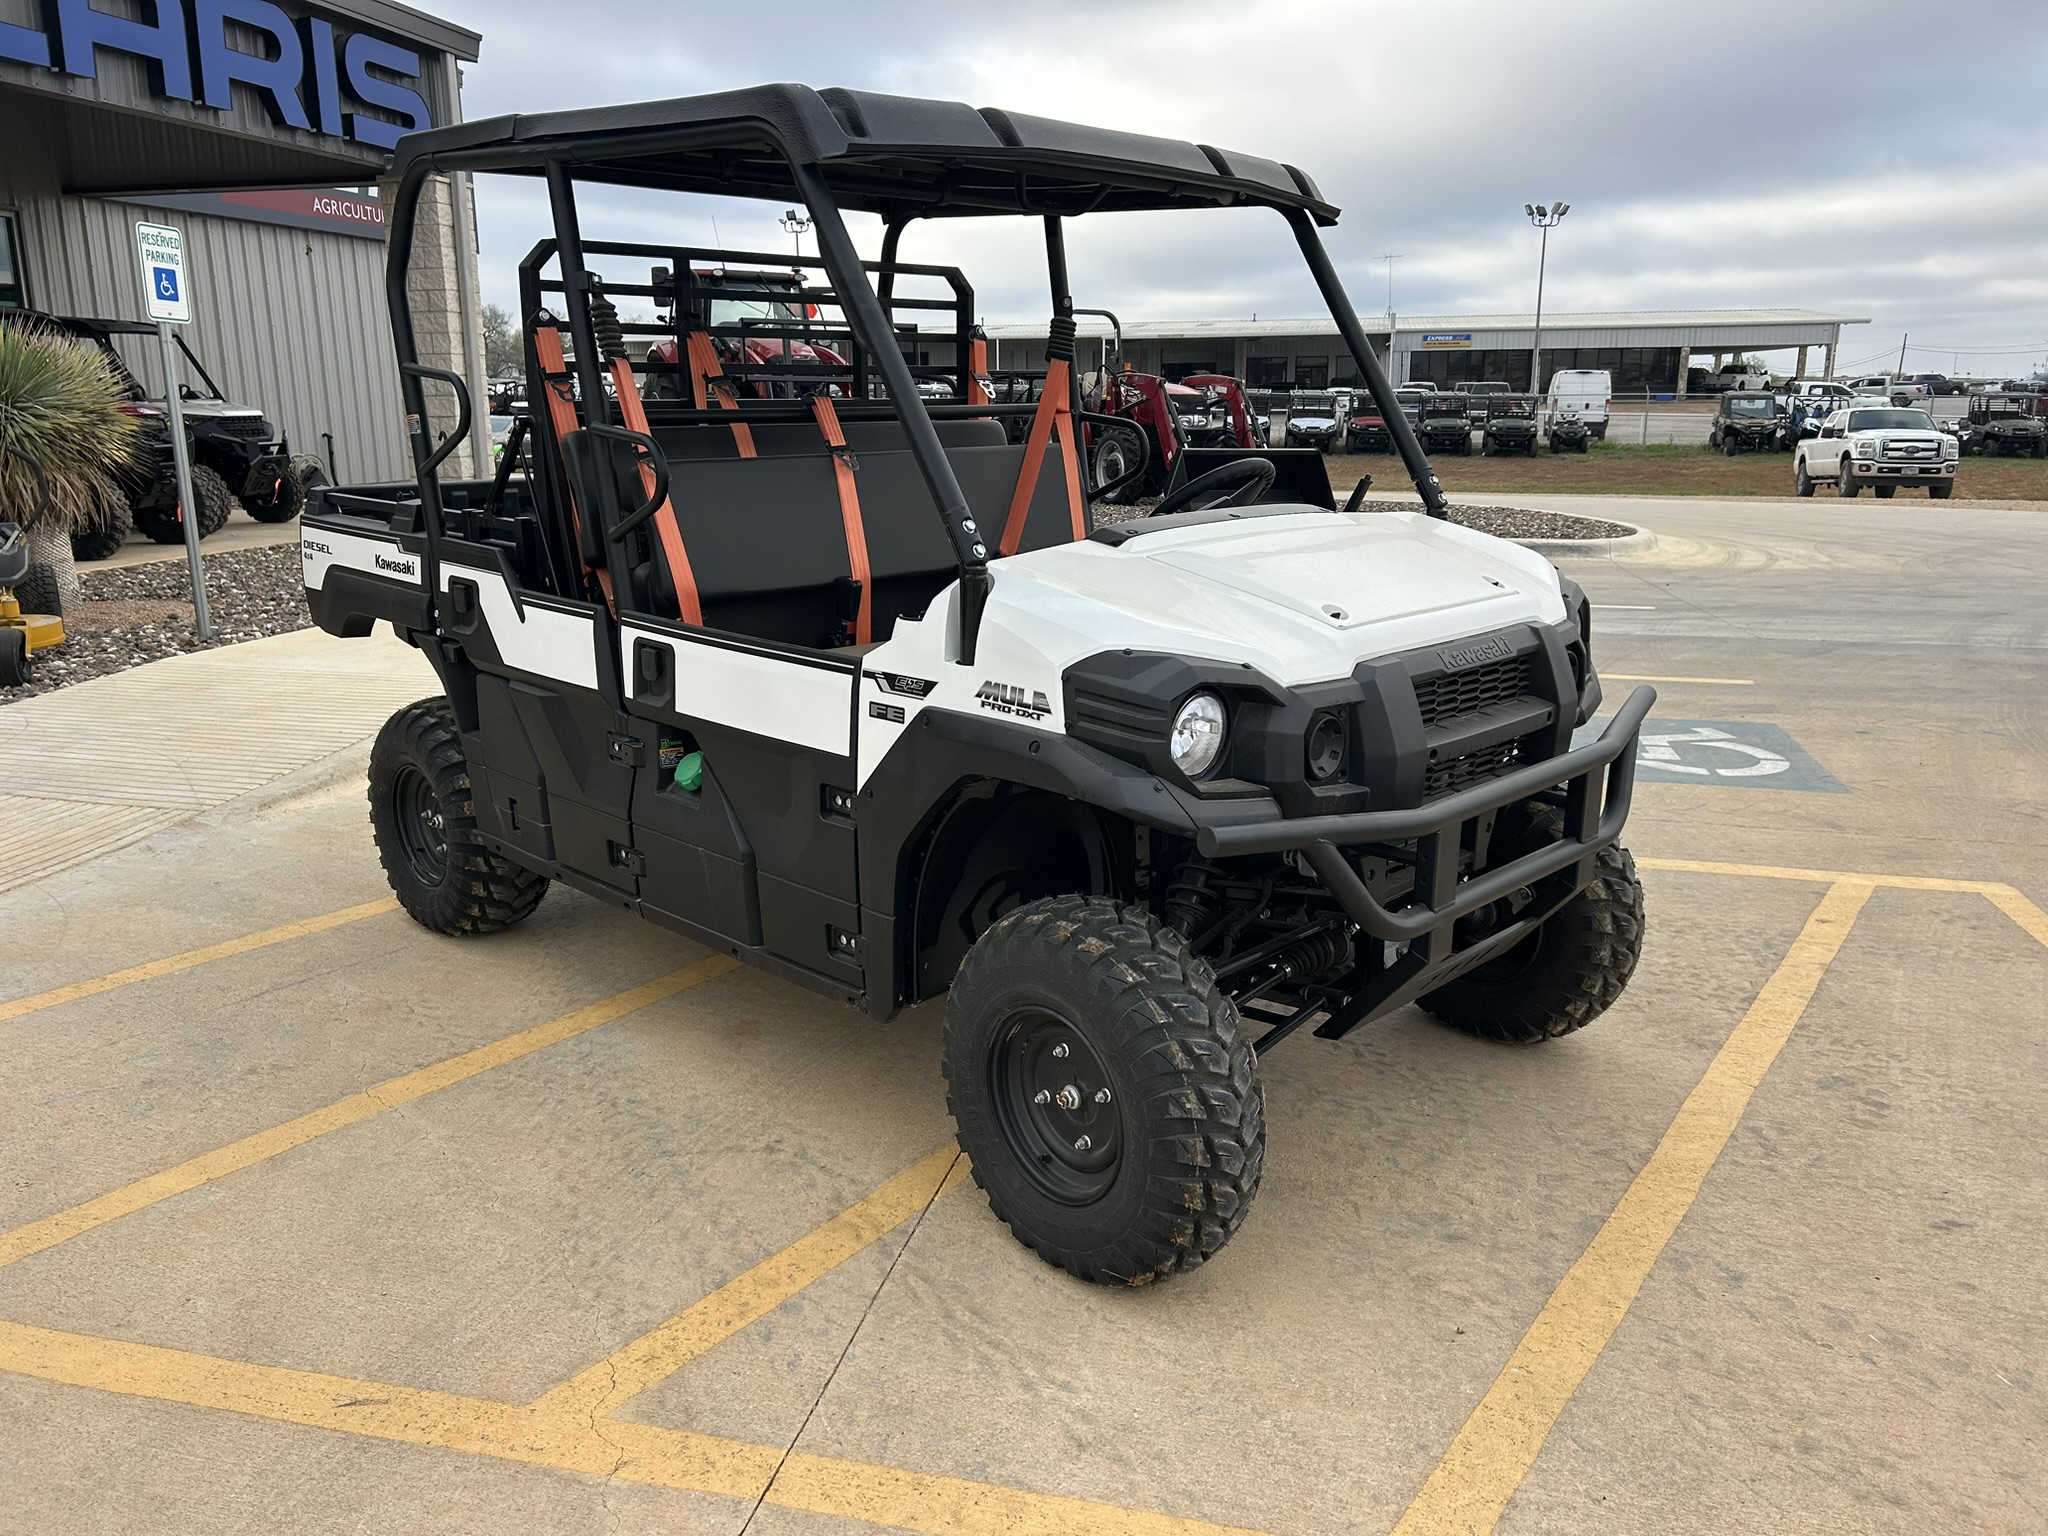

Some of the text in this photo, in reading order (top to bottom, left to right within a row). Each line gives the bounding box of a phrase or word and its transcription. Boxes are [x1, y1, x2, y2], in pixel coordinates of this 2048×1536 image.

[140, 232, 180, 250] RESERVED
[145, 249, 179, 266] PARKING
[303, 540, 333, 555] DIESEL
[374, 554, 416, 576] Kawasaki
[1436, 635, 1513, 670] Kawasaki
[974, 680, 1053, 715] MULE
[870, 702, 904, 723] FE
[980, 700, 1045, 721] PRO-DXT
